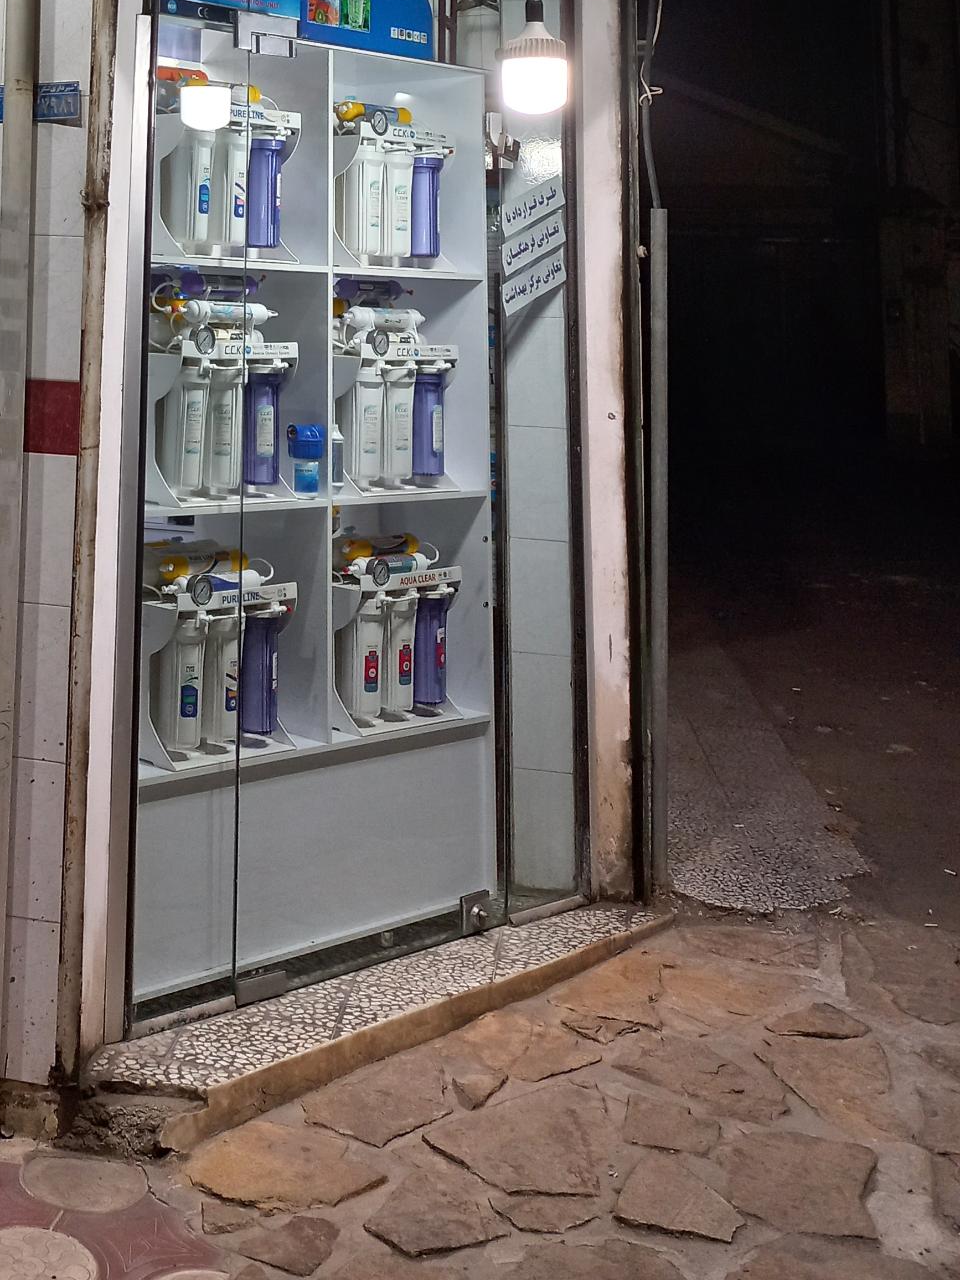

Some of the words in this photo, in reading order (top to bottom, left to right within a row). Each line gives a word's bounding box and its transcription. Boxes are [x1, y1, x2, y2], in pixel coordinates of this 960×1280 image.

[538, 185, 557, 207] طرف
[537, 221, 560, 247] تعاونی
[506, 233, 537, 266] فرهنگیان
[542, 259, 562, 284] تعاونی
[399, 576, 418, 586] AQUA
[418, 573, 437, 583] CLEAR
